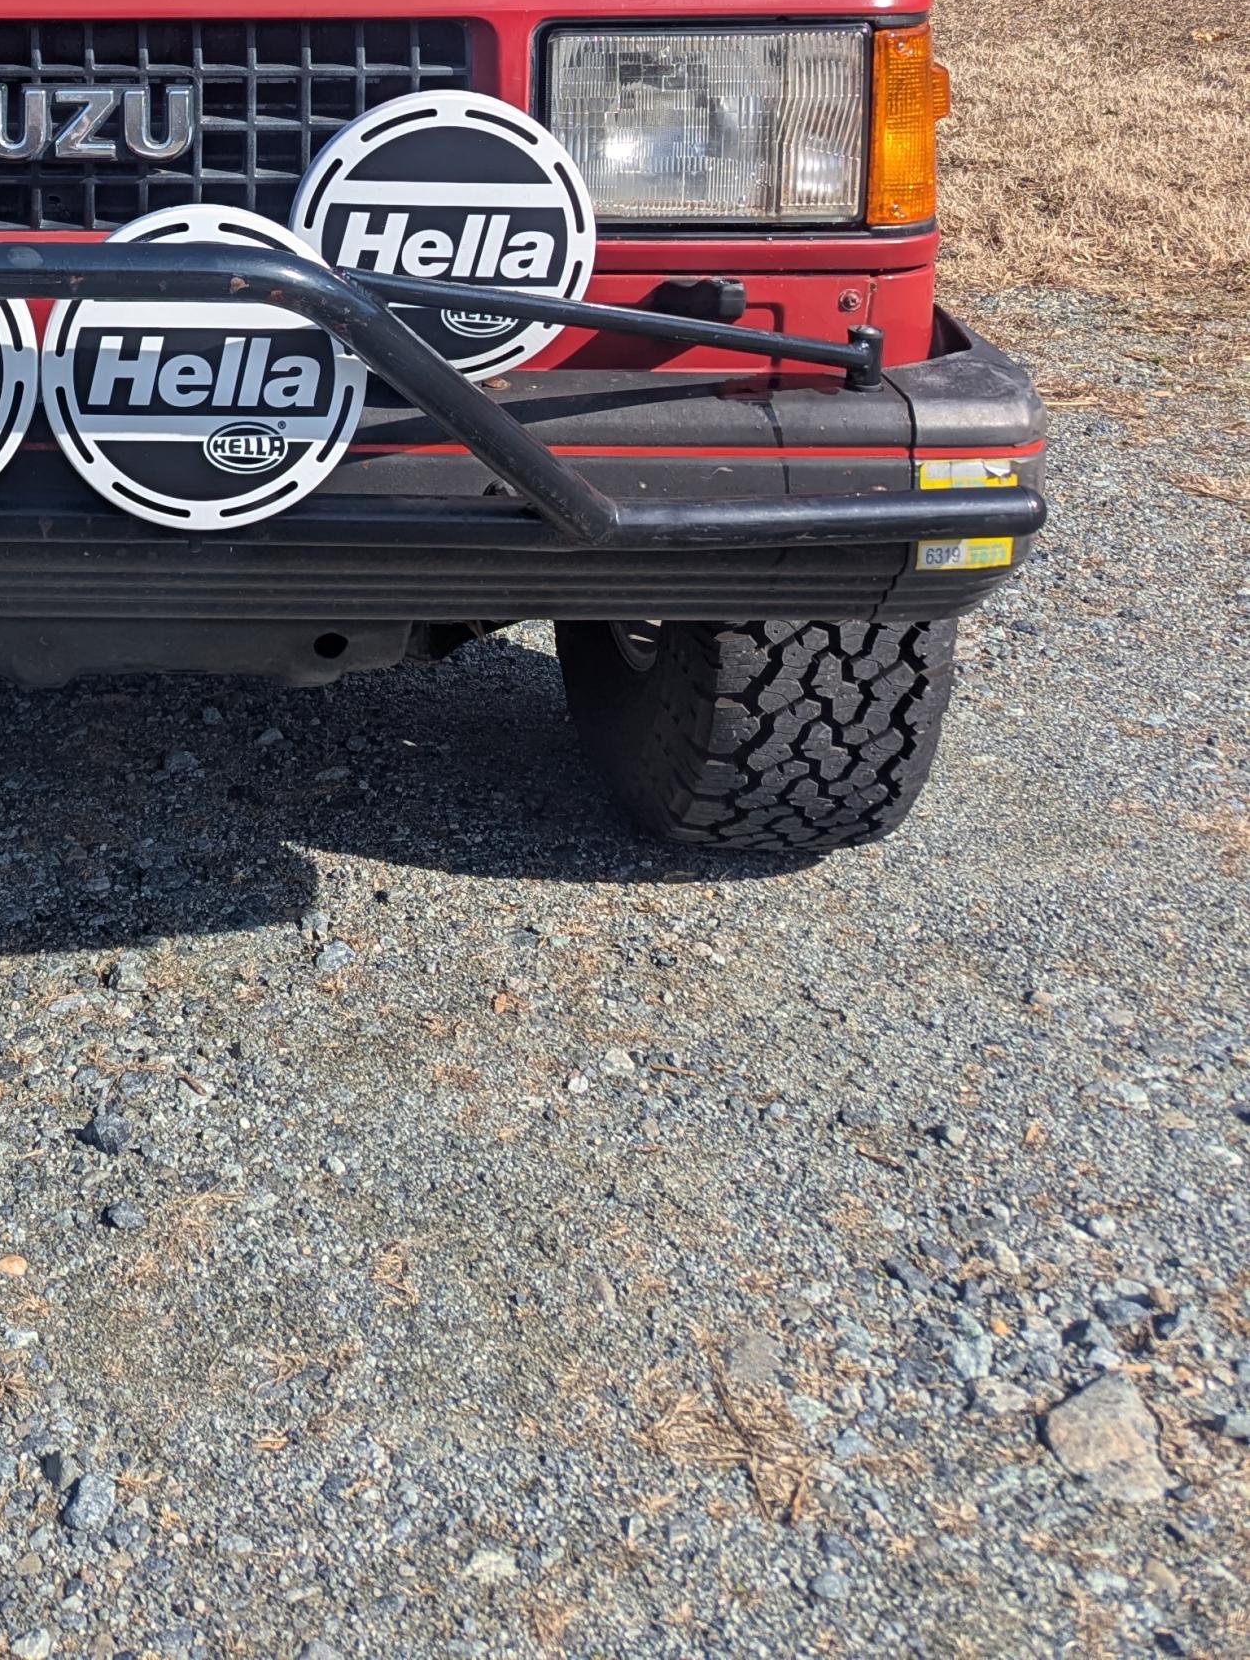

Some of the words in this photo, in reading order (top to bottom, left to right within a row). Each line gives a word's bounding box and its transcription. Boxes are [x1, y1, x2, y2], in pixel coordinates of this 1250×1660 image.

[336, 211, 555, 279] Hella
[87, 336, 322, 408] Hella
[212, 435, 285, 458] HELLA
[925, 547, 961, 565] 6319
